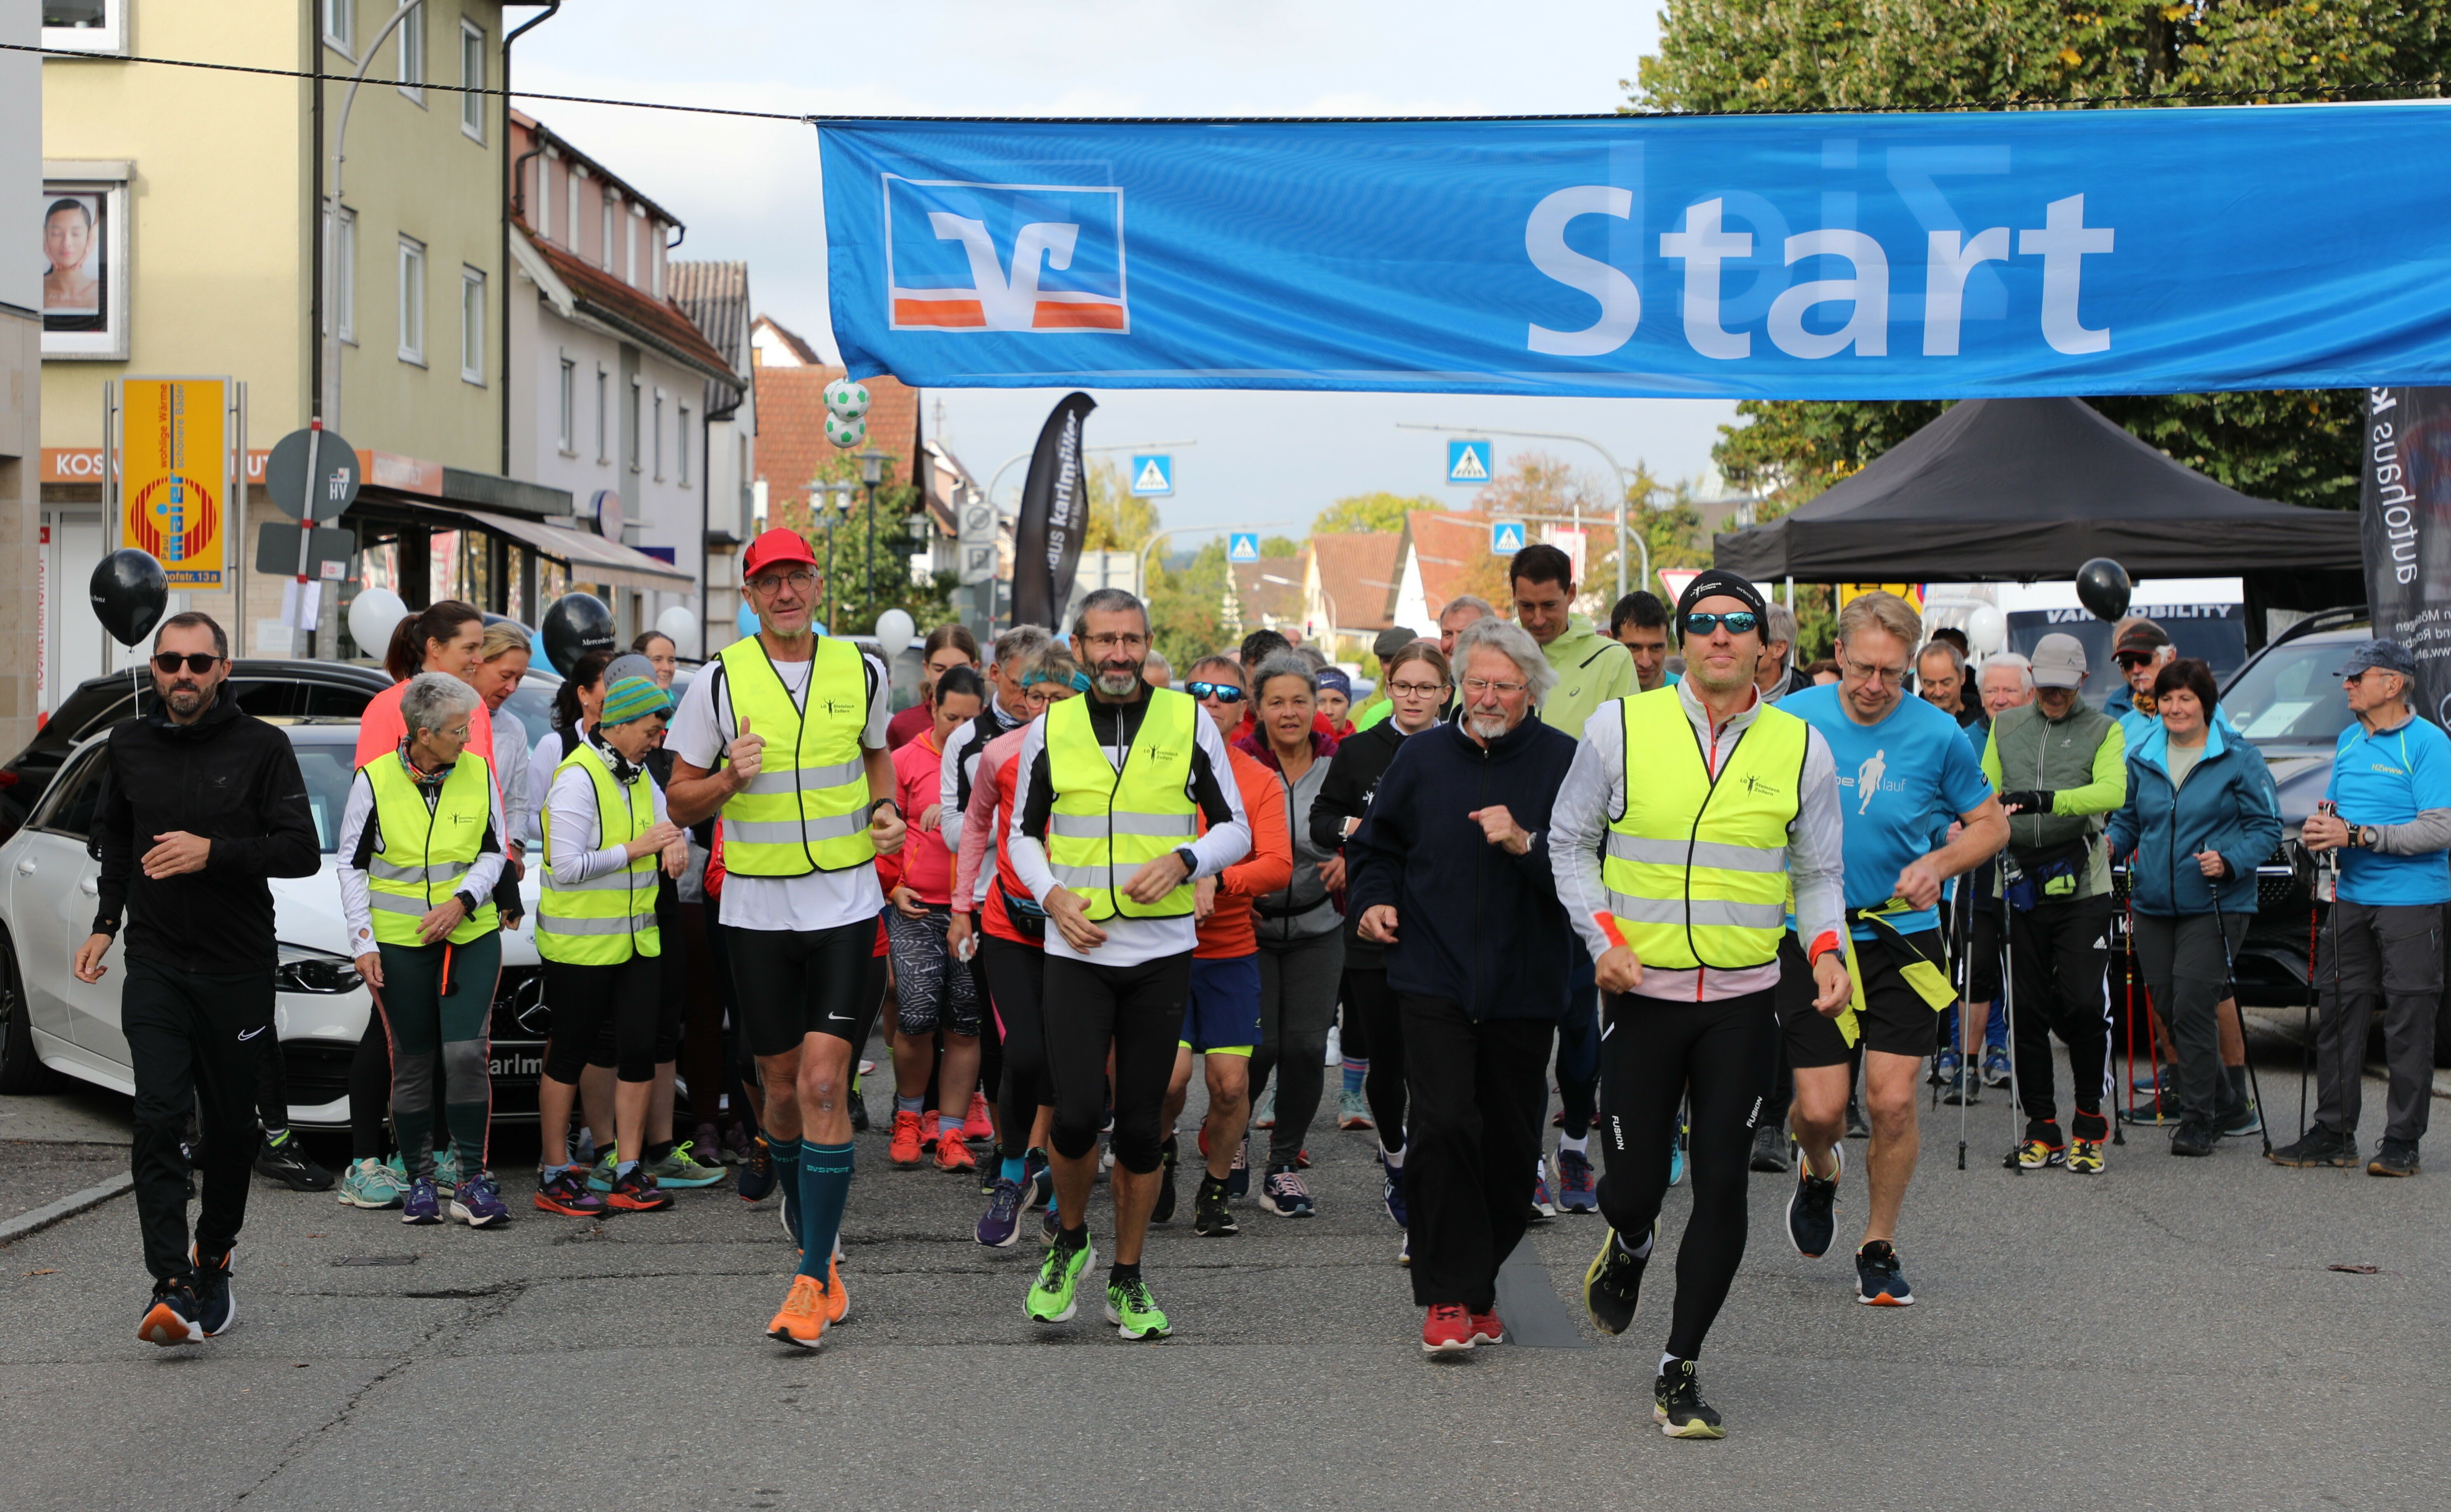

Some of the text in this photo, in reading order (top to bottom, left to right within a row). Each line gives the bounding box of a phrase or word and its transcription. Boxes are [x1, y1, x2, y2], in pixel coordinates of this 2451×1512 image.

[1525, 185, 2114, 359] Start
[176, 383, 184, 415] Bäder
[159, 384, 169, 469] wohlige Wärme
[330, 483, 348, 500] HV
[156, 473, 183, 561] maier
[1754, 787, 1774, 797] Zollern
[1755, 782, 1780, 794] Steinlach
[1883, 777, 1906, 792] lauf
[1746, 1096, 1762, 1128] FUSION
[1612, 1115, 1624, 1150] FUSION
